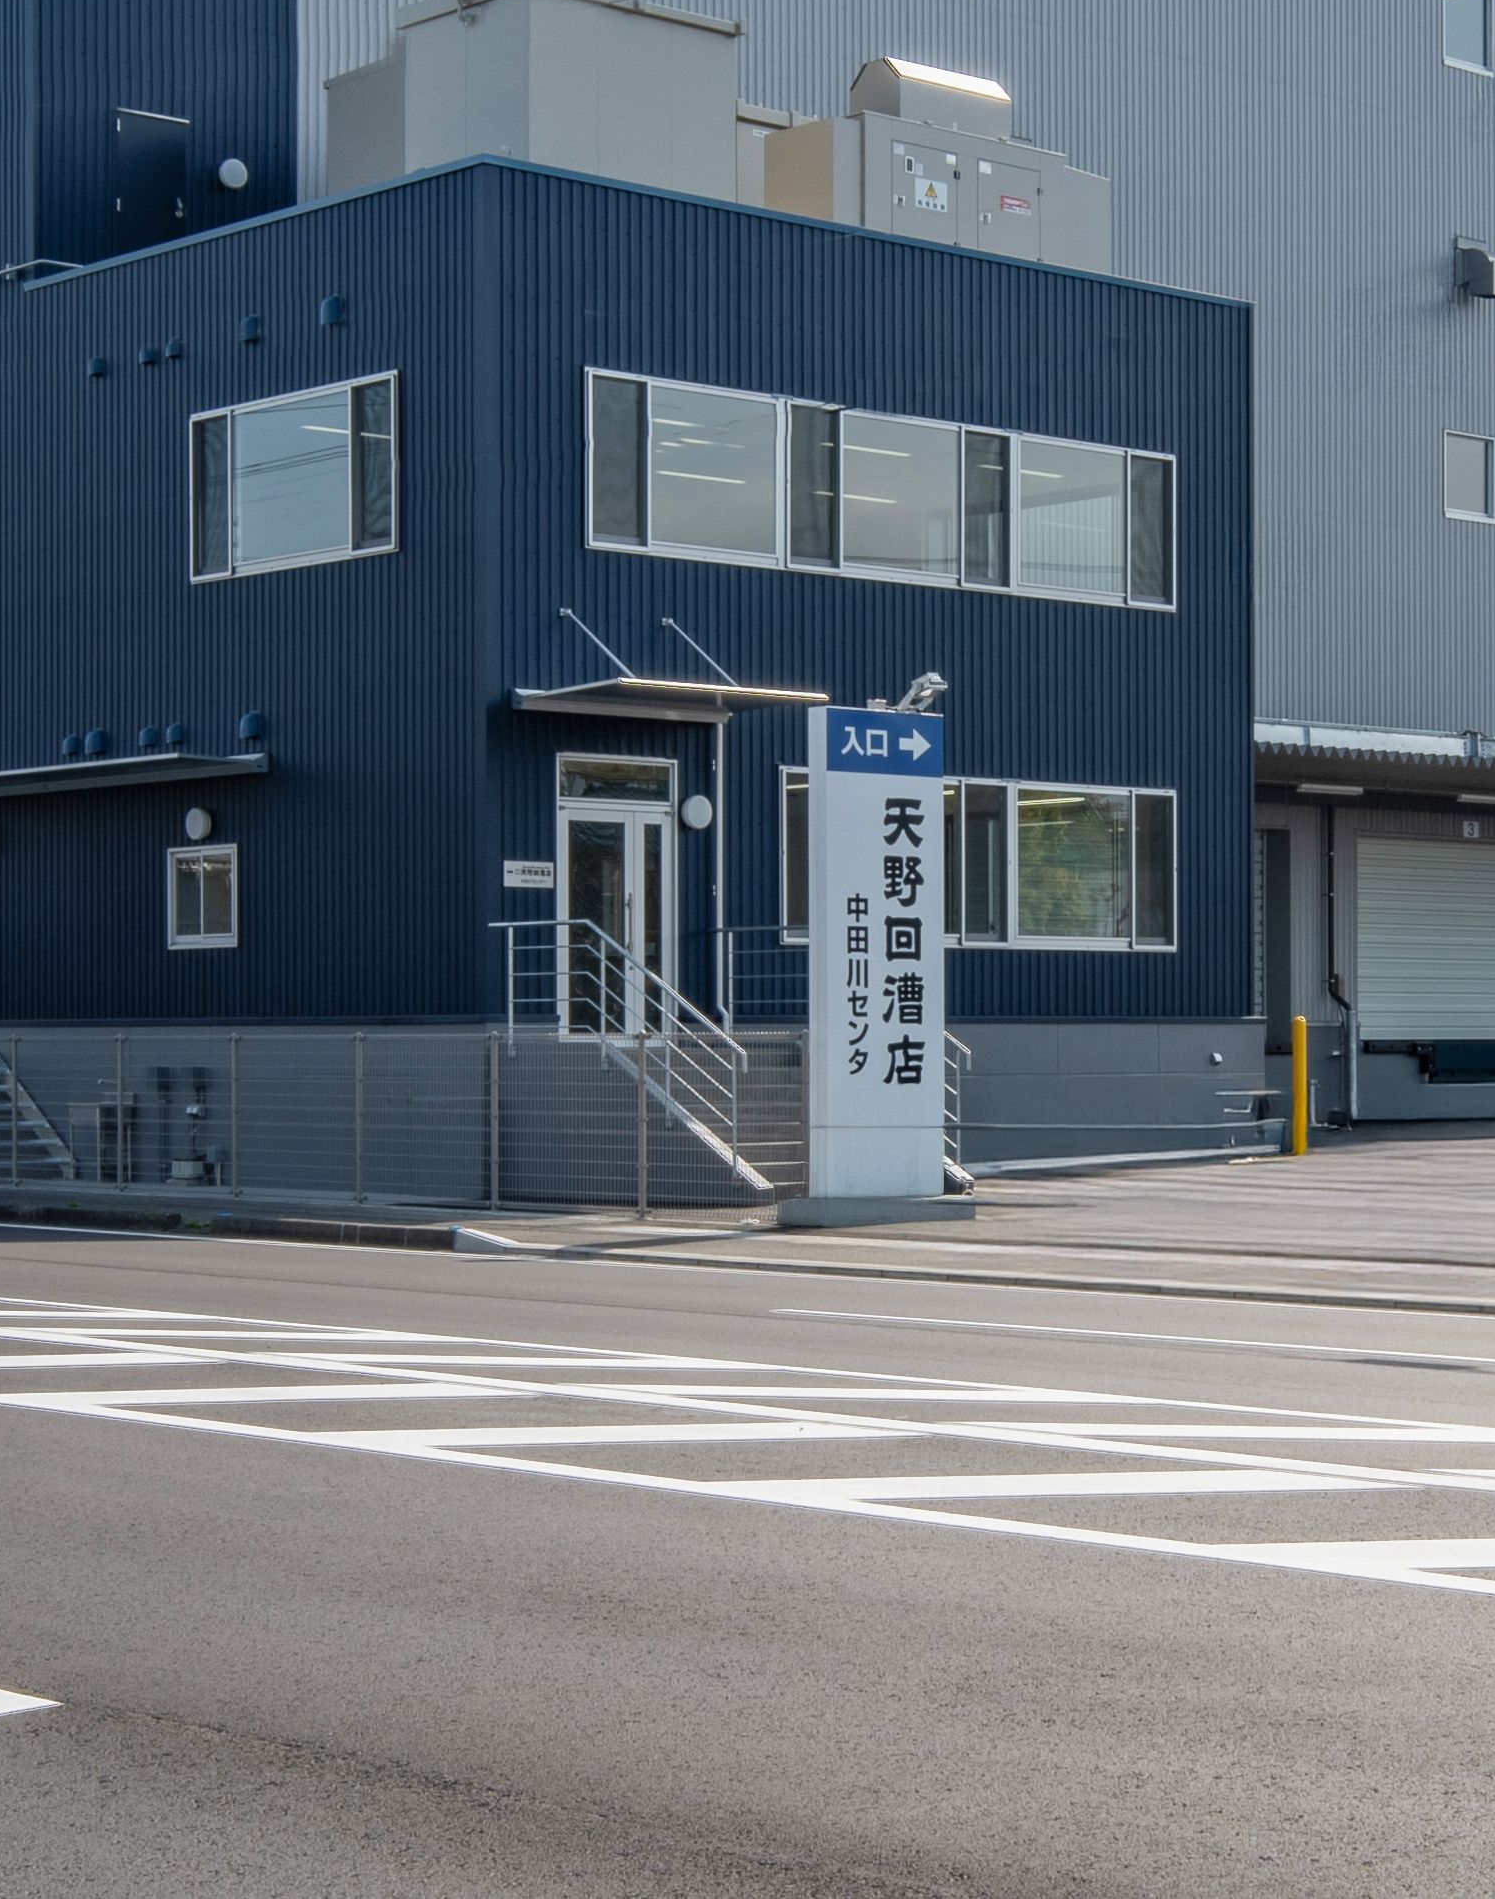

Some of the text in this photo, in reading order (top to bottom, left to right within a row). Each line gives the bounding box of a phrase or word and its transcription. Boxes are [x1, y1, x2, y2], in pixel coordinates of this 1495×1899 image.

[840, 725, 889, 758] 入口
[1467, 822, 1475, 837] 3
[846, 892, 869, 1075] 中田川センタ
[882, 797, 926, 1085] 天野回漕店
